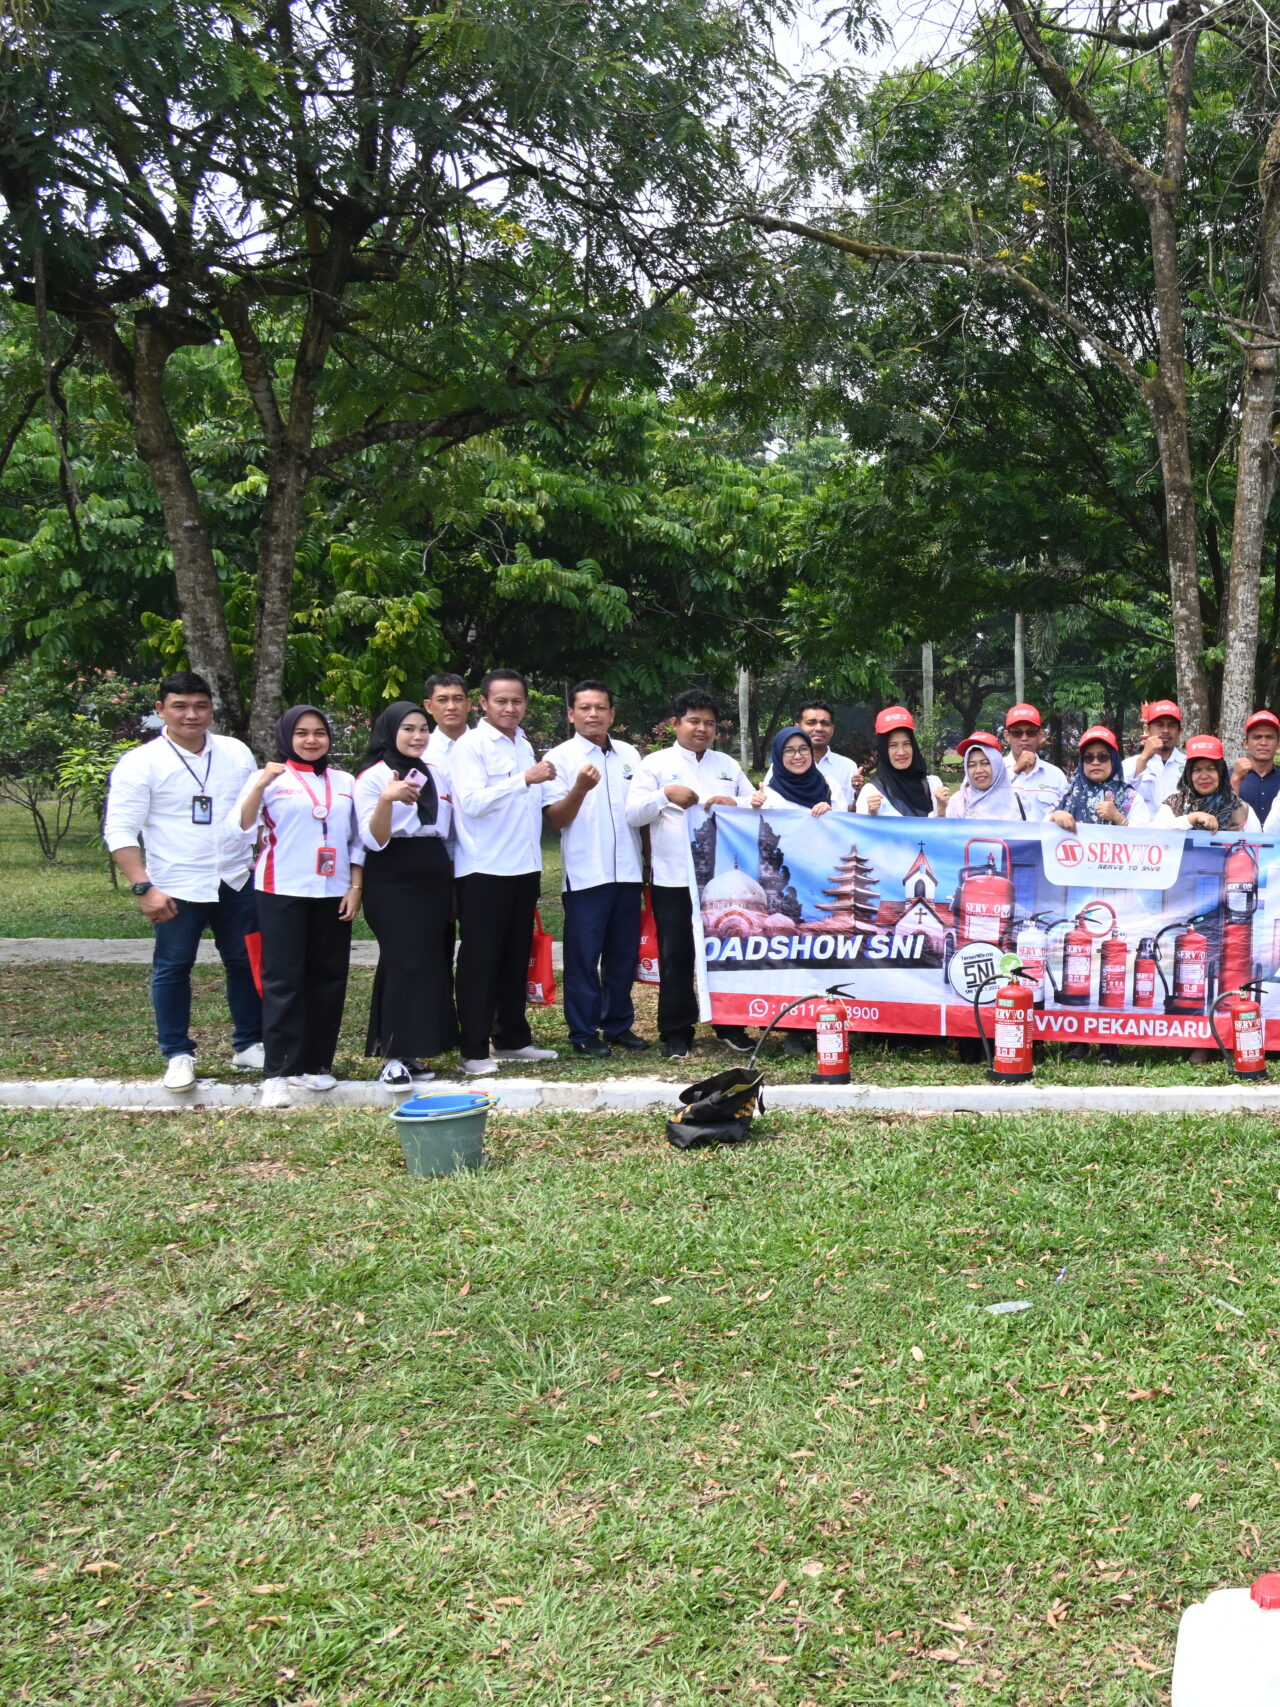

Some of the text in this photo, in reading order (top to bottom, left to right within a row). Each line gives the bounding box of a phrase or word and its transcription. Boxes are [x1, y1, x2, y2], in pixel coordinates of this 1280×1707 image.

[1088, 842, 1162, 866] SERVVO
[705, 935, 924, 961] OADSHOW SNI
[964, 961, 995, 985] SNI
[1034, 1016, 1211, 1039] VVO PEKANBARU
